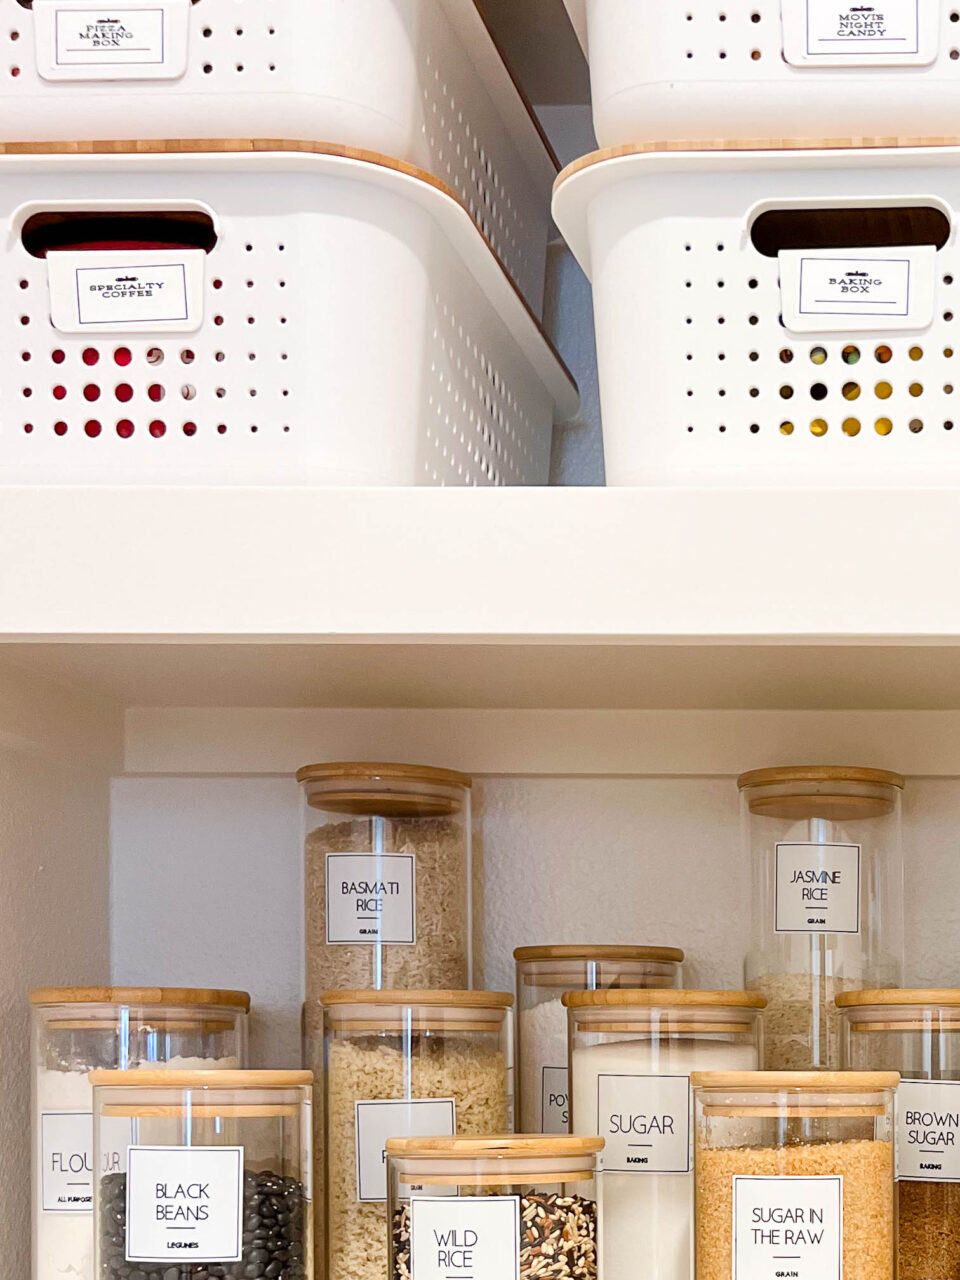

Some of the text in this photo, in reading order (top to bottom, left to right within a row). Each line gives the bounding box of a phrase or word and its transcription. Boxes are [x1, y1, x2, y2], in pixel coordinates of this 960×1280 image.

[85, 24, 127, 32] PIZZA
[836, 29, 887, 37] CANDY
[79, 32, 134, 40] MAKING
[89, 282, 165, 292] SPECIALTY
[828, 278, 883, 286] BAKING
[101, 290, 153, 299] COFFEE
[840, 286, 870, 294] BOX
[341, 881, 399, 895] BASMATI
[801, 887, 828, 901] RICE
[356, 898, 383, 912] RICE
[609, 1114, 674, 1135] SUGAR
[905, 1111, 959, 1128] BROWN
[908, 1130, 955, 1146] SUGAR
[155, 1183, 210, 1199] BLACK
[156, 1205, 209, 1221] BEANS
[752, 1207, 823, 1224] SUGAR IN
[433, 1229, 478, 1247] WILD
[751, 1228, 825, 1245] THE RAW
[438, 1250, 473, 1268] RICE
